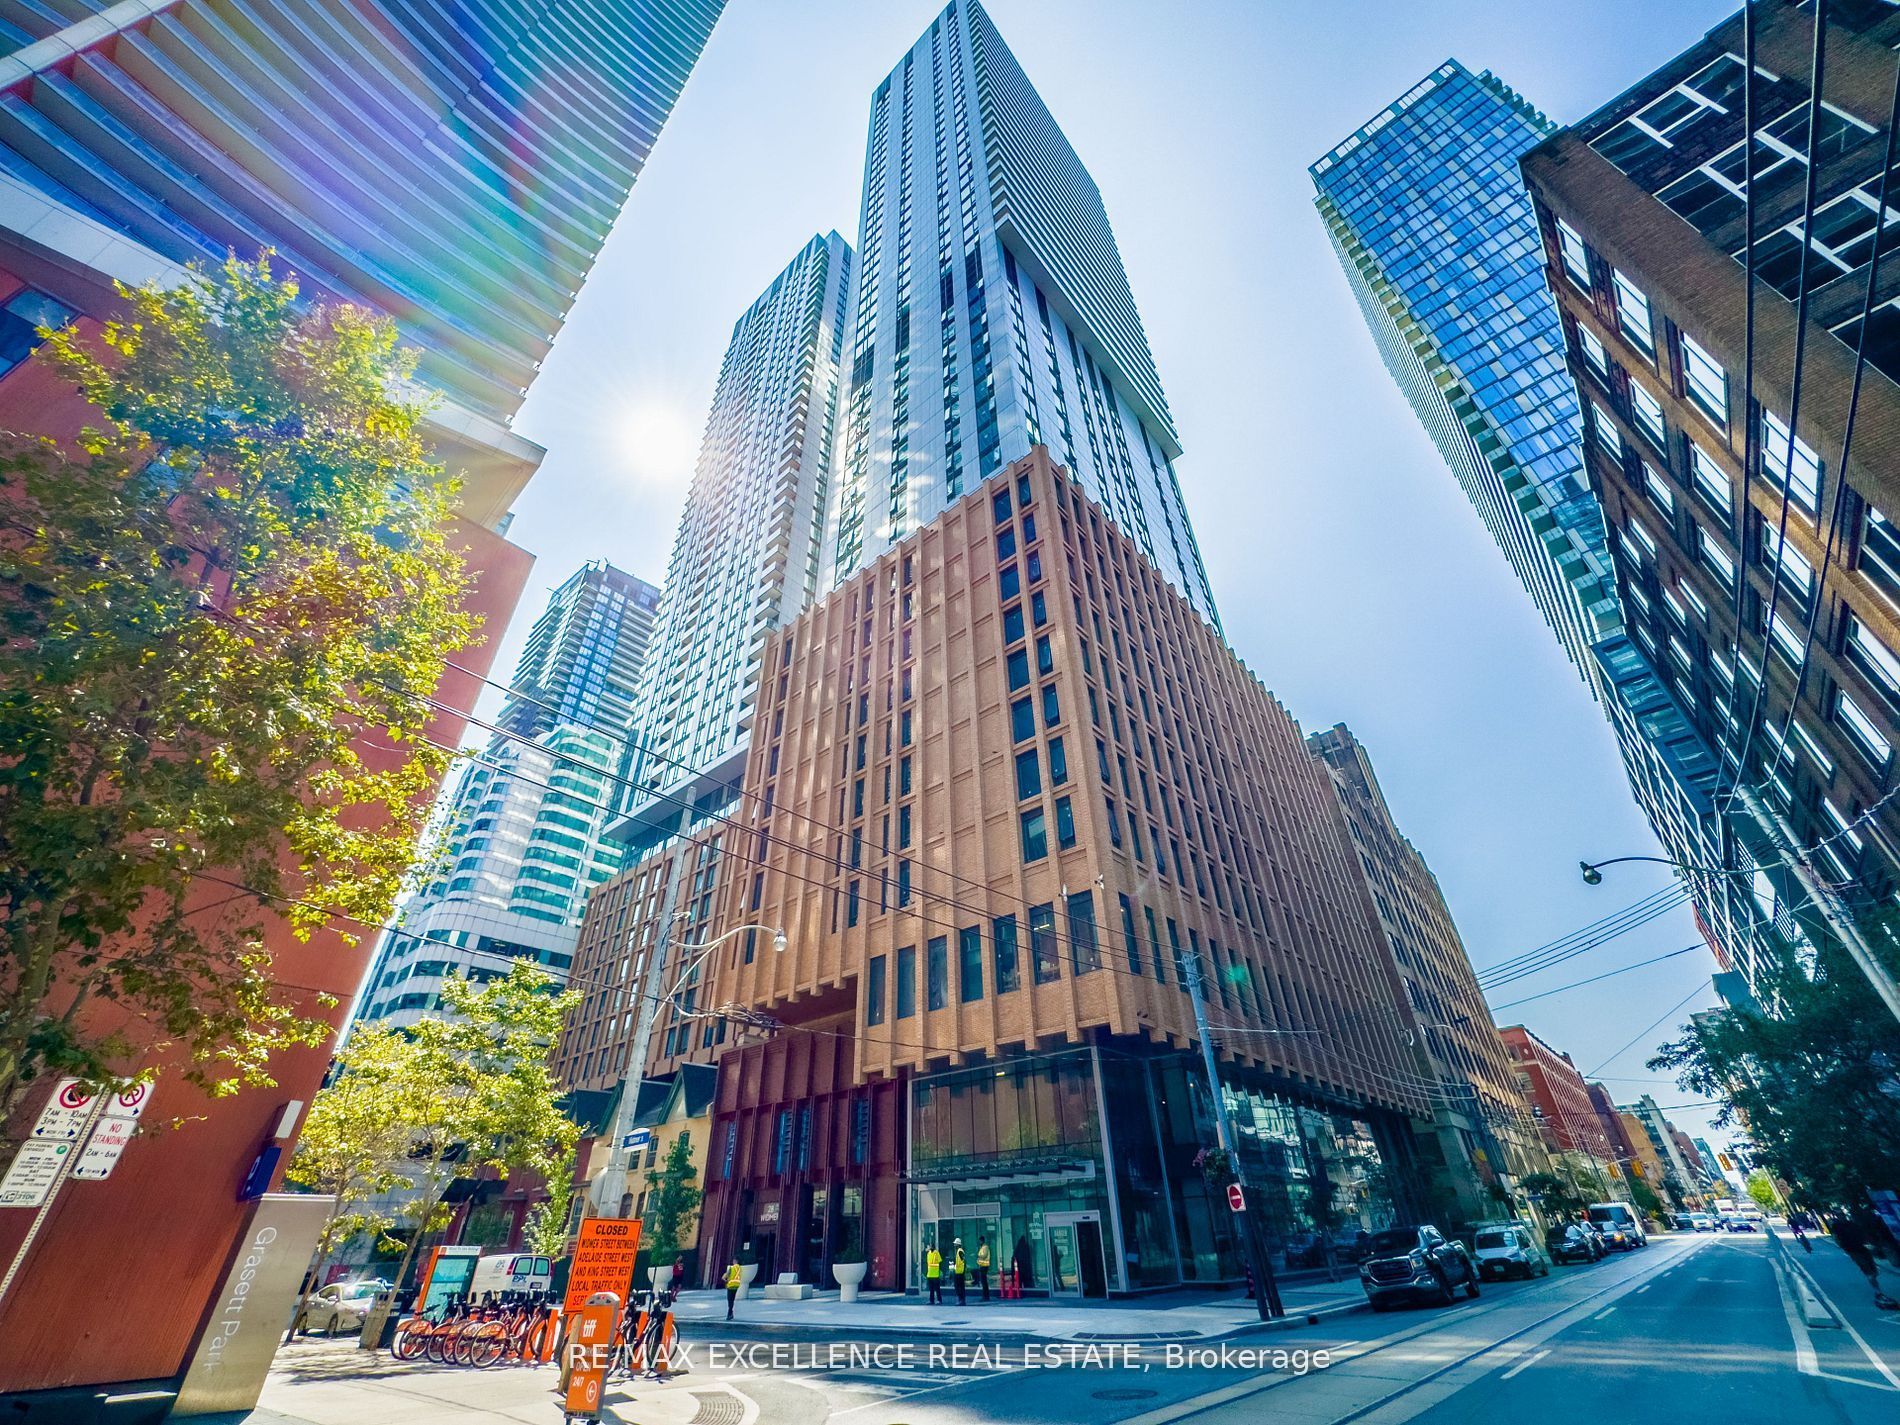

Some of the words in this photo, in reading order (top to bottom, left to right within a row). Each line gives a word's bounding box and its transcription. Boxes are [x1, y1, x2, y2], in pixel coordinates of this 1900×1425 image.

[45, 1107, 60, 1116] 7AM
[70, 1109, 88, 1119] 10AM
[41, 1116, 56, 1126] 3PM
[66, 1118, 82, 1128] 7PM
[109, 1123, 122, 1134] NO
[93, 1134, 127, 1146] STANDING
[595, 1225, 628, 1236] CLOSED
[600, 1239, 616, 1249] STREET
[578, 1252, 603, 1263] ADELAIDE
[603, 1252, 621, 1263] STREET
[621, 1253, 633, 1263] WEST
[225, 1226, 277, 1314] Grasett
[575, 1266, 587, 1277] AND
[588, 1266, 600, 1277] KING
[600, 1266, 618, 1277] STREET
[618, 1266, 630, 1276] WEST
[571, 1280, 589, 1291] LOCAL
[591, 1280, 613, 1291] TRAFFIC
[613, 1280, 626, 1291] ONLY
[204, 1321, 240, 1373] Park
